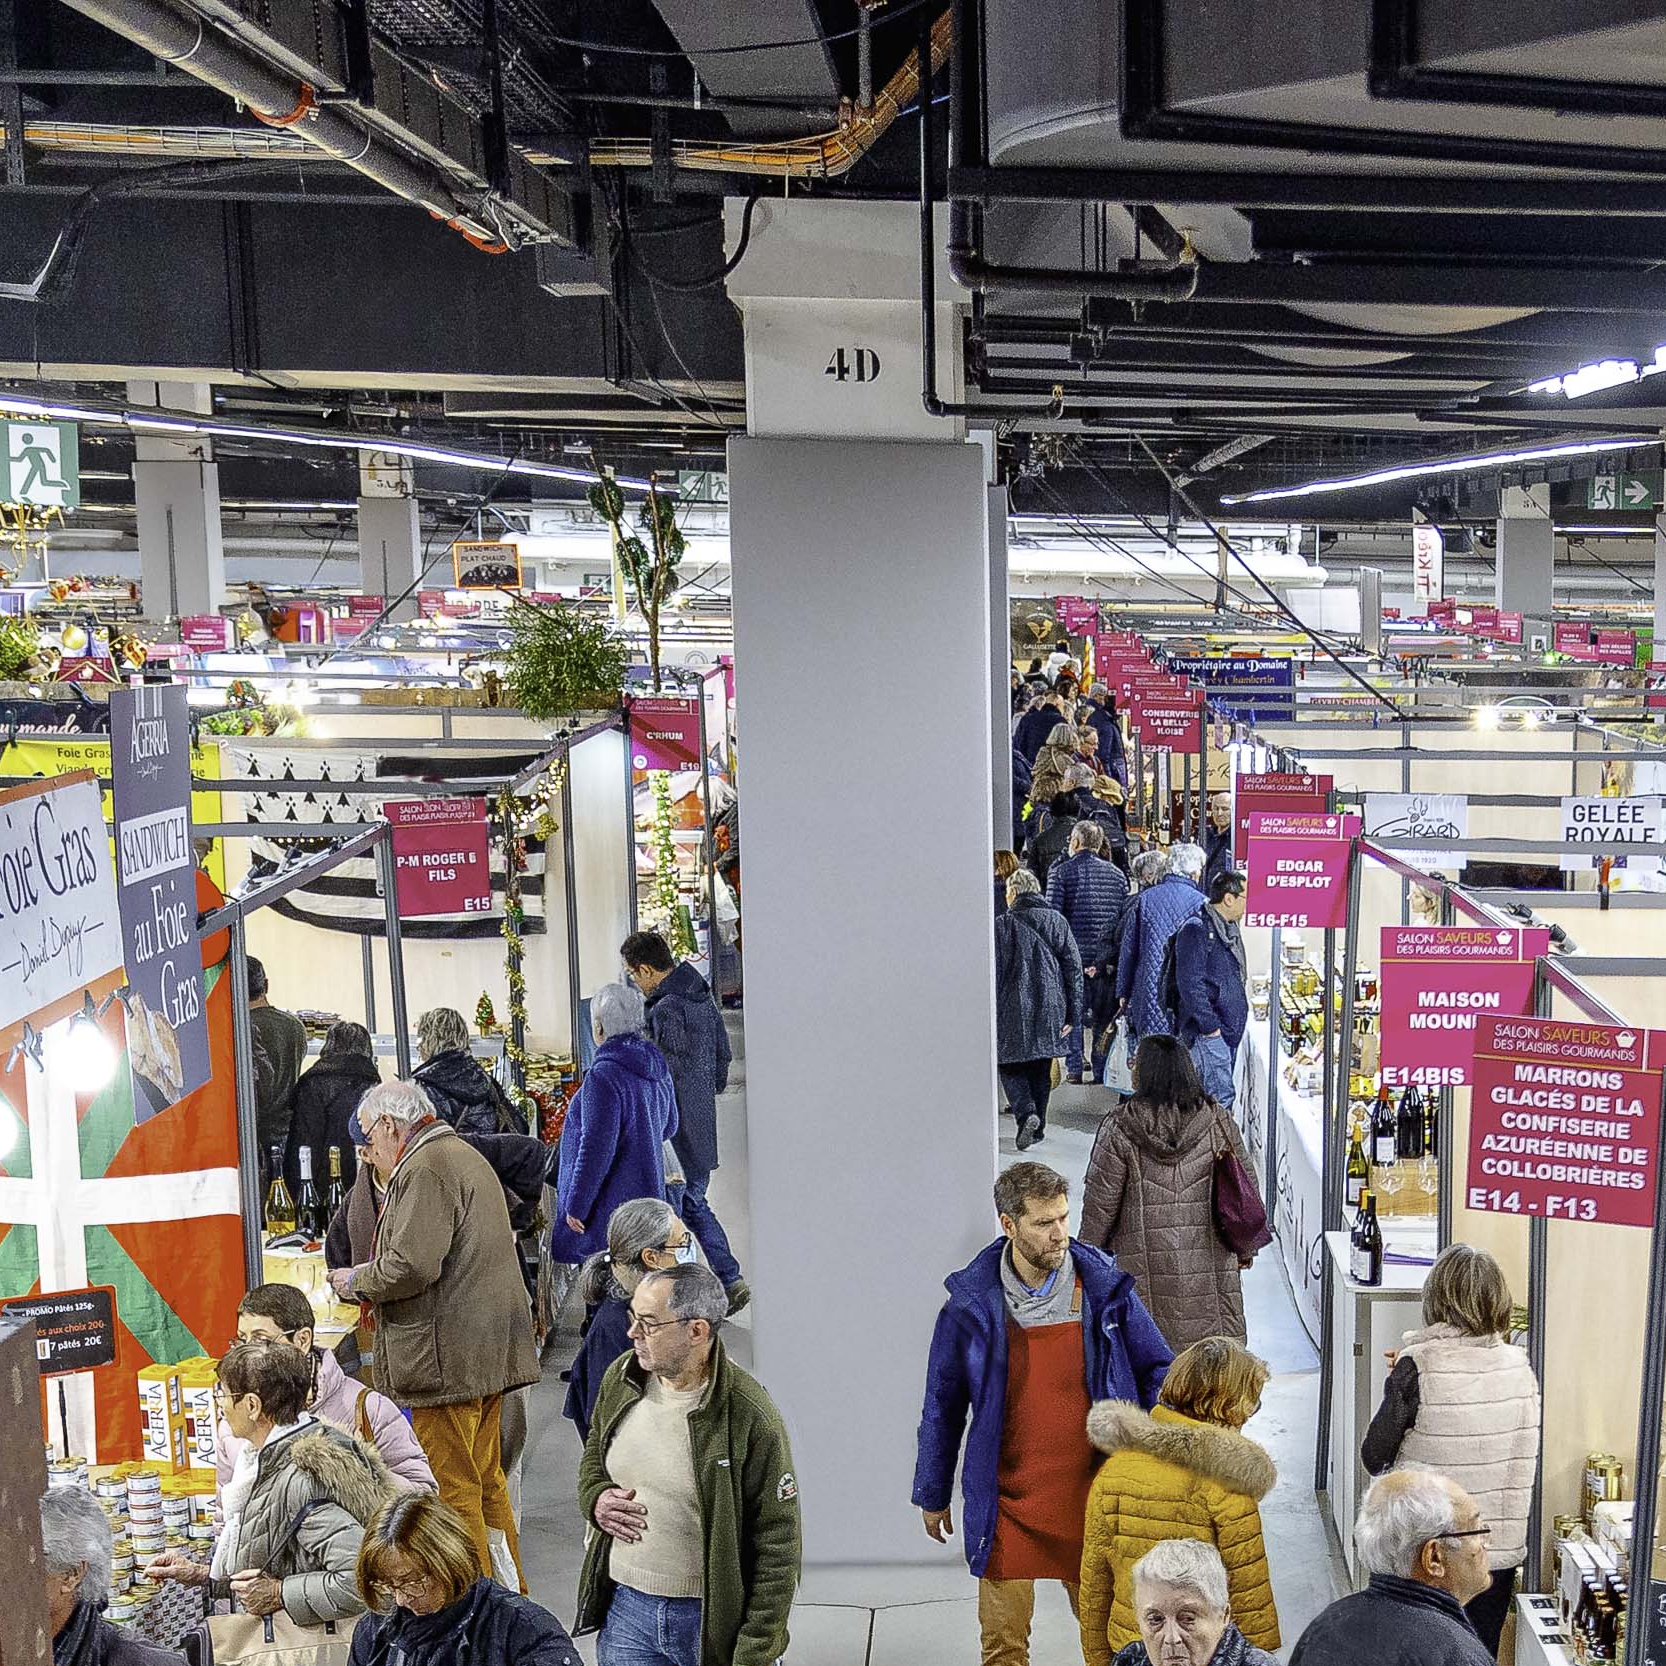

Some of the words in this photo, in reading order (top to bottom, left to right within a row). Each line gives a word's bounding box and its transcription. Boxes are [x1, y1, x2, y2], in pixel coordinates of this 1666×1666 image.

[825, 345, 882, 384] 4D
[1233, 661, 1244, 670] au
[1246, 659, 1288, 671] Domaine
[1142, 709, 1200, 719] CONSERVERIE
[1150, 719, 1161, 727] LA
[1163, 719, 1191, 728] BELLE-
[646, 731, 683, 741] C'RHUM
[1157, 728, 1184, 736] ILOISE
[131, 718, 170, 763] AGERRIA
[58, 748, 80, 758] Foie
[1244, 777, 1265, 785] SALON
[1571, 798, 1644, 826] GELÉE
[1260, 818, 1285, 826] SALON
[1287, 817, 1323, 826] SAVEURS
[1298, 827, 1337, 835] GOURMANDS
[1564, 825, 1657, 844] ROYALE
[32, 800, 97, 898] Gras
[123, 817, 189, 878] SANDWICH
[396, 856, 418, 868] P-M
[423, 853, 466, 865] ROGER
[1277, 861, 1323, 872] EDGAR
[428, 869, 456, 881] FILS
[1267, 876, 1333, 889] D'ESPLOT
[464, 899, 490, 911] E15
[134, 919, 153, 963] au
[150, 880, 190, 956] Foie
[1247, 914, 1308, 927] E16-F15
[1397, 933, 1433, 944] SALON
[1437, 932, 1492, 945] SAVEURS
[1397, 945, 1414, 954] DES
[1415, 945, 1450, 954] PLAISIRS
[1452, 945, 1513, 955] GOURMANDS
[161, 960, 199, 1030] Gras
[1418, 992, 1499, 1008] MAISON
[1494, 1023, 1539, 1039] SALON
[1542, 1027, 1610, 1044] SAVEURS
[1493, 1038, 1514, 1050] DES
[1516, 1040, 1558, 1055] PLAISIRS
[1560, 1045, 1636, 1061] GOURMANDS
[1382, 1067, 1465, 1085] E14BIS
[1514, 1065, 1623, 1090] MARRONS
[1490, 1085, 1575, 1110] GLACÉS
[1581, 1096, 1608, 1113] DE
[1612, 1099, 1645, 1117] LA
[1501, 1112, 1631, 1140] CONFISERIE
[1481, 1133, 1613, 1164] AZURÉENNE
[1618, 1147, 1648, 1166] DE
[1481, 1157, 1646, 1189] COLLOBRIÈRES
[1468, 1188, 1521, 1213] E14
[1546, 1197, 1597, 1219] F13
[55, 1303, 74, 1314] Pâtés
[48, 1326, 64, 1335] aux
[64, 1323, 86, 1334] choix
[50, 1342, 57, 1351] 7
[57, 1339, 81, 1352] pâtés
[84, 1336, 102, 1347] 20€
[149, 1384, 168, 1459] AGERRIA
[197, 1390, 216, 1466] AGERRIA
